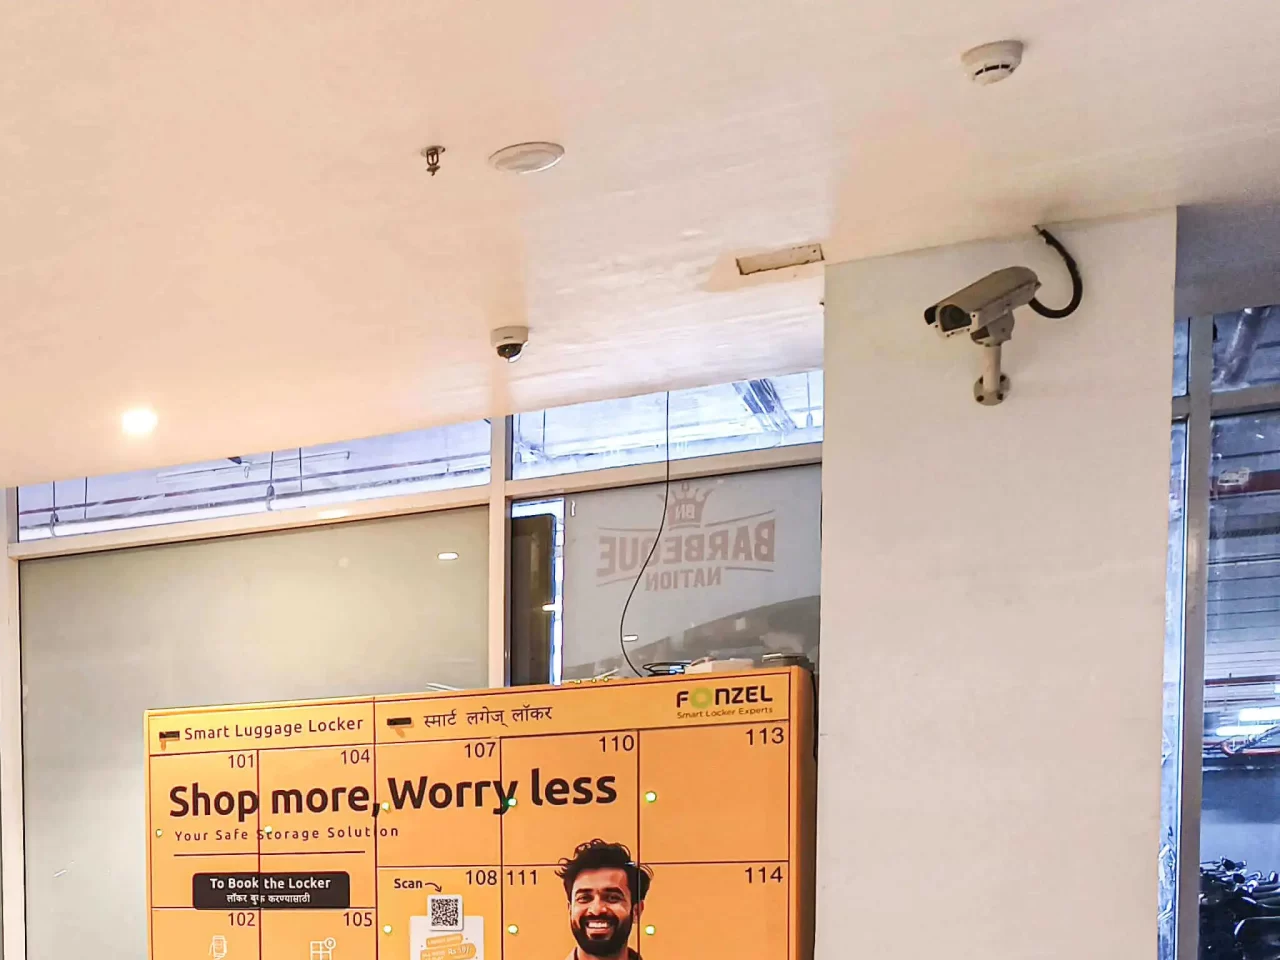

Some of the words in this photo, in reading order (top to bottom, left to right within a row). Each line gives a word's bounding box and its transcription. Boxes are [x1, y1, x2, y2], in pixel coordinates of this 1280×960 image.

[677, 685, 773, 709] FONZEL
[423, 709, 457, 728] स्मार्ट
[511, 704, 553, 722] लॉकर
[677, 711, 703, 719] Smart
[706, 709, 735, 717] Locker
[738, 707, 773, 716] Experts
[184, 725, 229, 740] Smart
[235, 721, 303, 739] Luggage
[308, 717, 364, 733] Locker
[745, 727, 785, 746] 113
[464, 742, 496, 758] 107
[599, 735, 635, 752] 110
[228, 754, 254, 769] 101
[340, 749, 370, 765] 104
[170, 782, 259, 822] Shop
[272, 786, 380, 817] more,
[387, 776, 518, 815] Worry
[531, 768, 617, 806] less
[175, 831, 209, 841] Your
[216, 829, 248, 840] Safe
[256, 828, 320, 842] Storage
[210, 878, 225, 889] To
[228, 877, 259, 889] Book
[264, 877, 285, 889] the
[289, 876, 331, 889] Locker
[394, 878, 423, 889] Scan
[465, 870, 497, 886] 108
[506, 870, 538, 886] 111
[745, 867, 784, 884] 114
[228, 912, 255, 927] 102
[343, 912, 373, 927] 105
